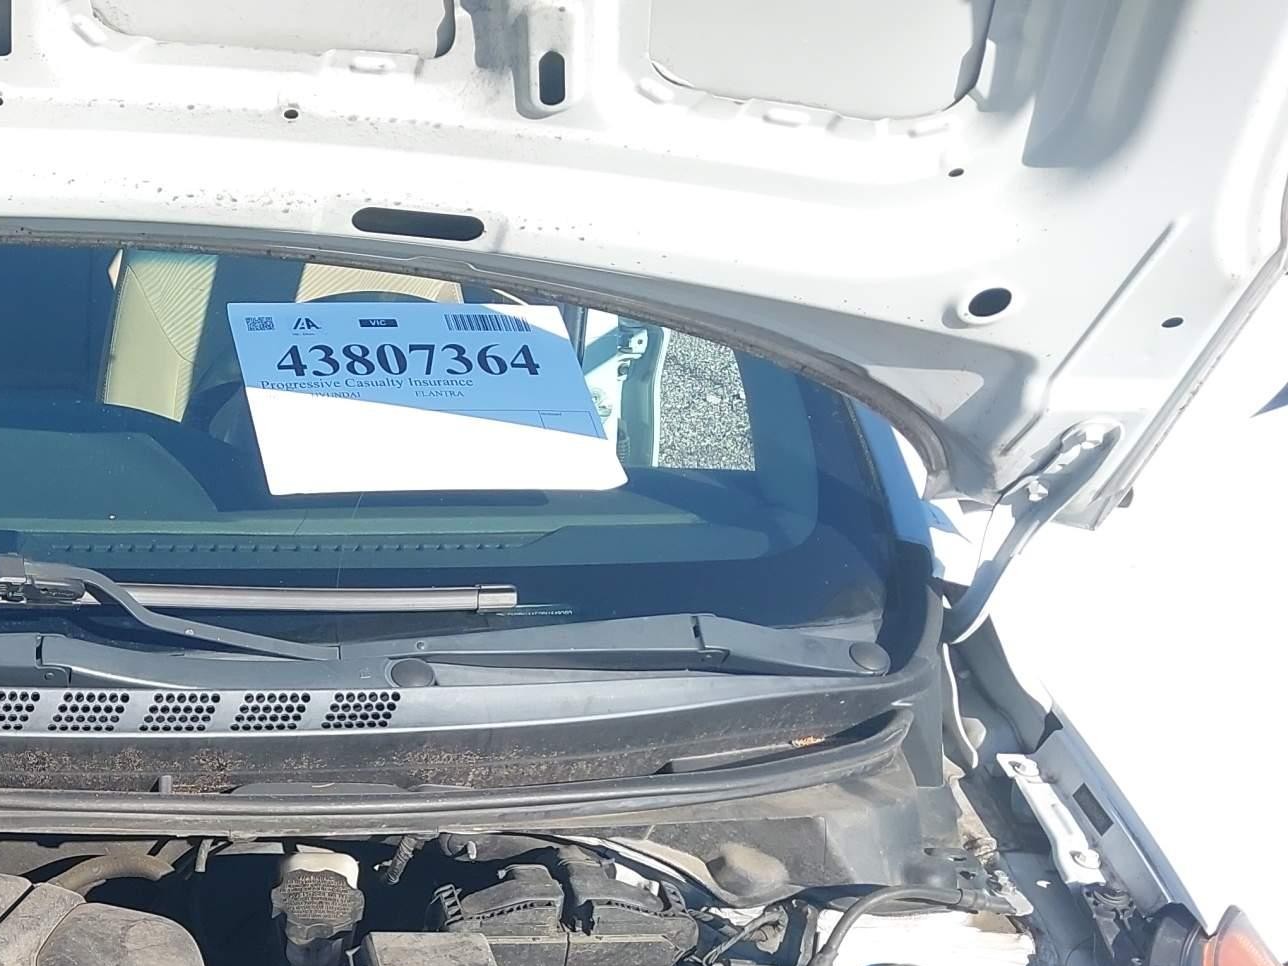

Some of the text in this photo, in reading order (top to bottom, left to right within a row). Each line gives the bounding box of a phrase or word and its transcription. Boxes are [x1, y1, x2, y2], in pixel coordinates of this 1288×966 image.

[369, 319, 387, 327] VIC
[277, 344, 540, 376] 43807364
[260, 376, 474, 392] Progressive Casualty Insurance
